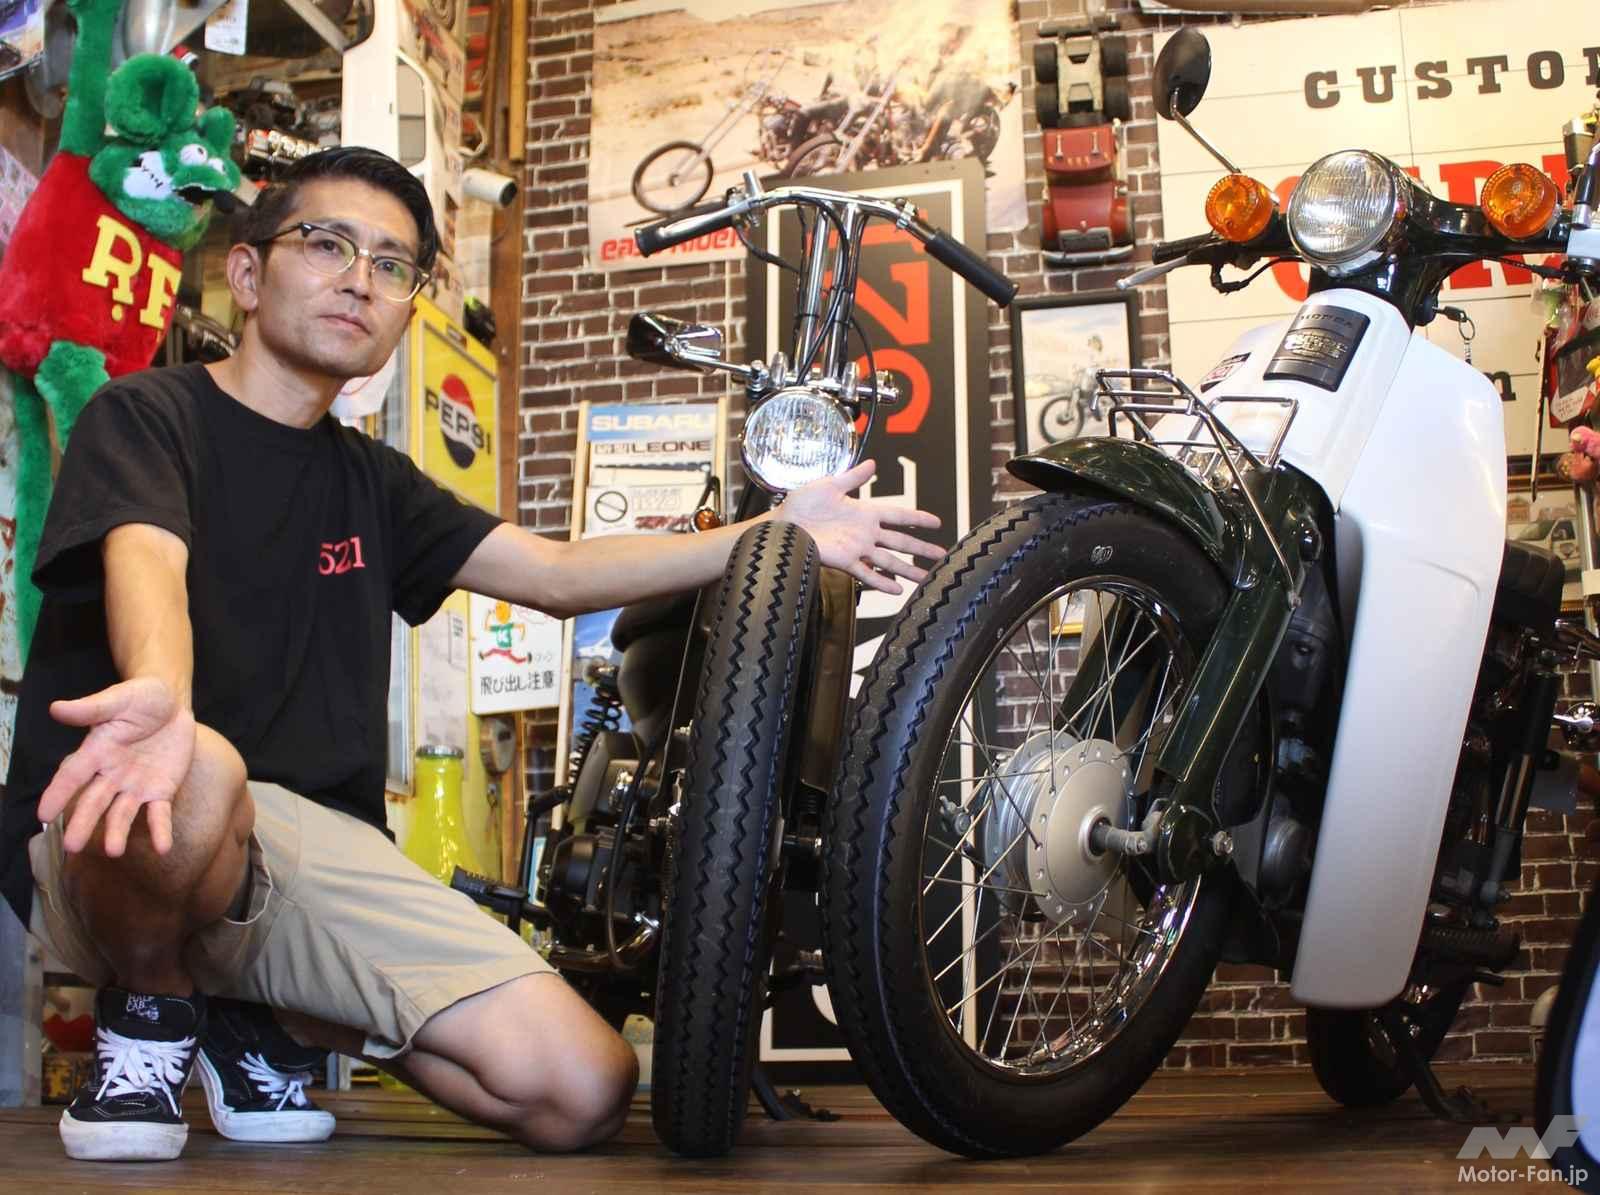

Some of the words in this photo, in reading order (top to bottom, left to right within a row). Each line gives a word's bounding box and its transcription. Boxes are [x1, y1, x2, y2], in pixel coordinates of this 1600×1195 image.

[425, 389, 491, 455] PEPSI
[591, 413, 715, 431] SUBARU
[633, 440, 711, 453] LEONE
[318, 536, 366, 576] 521
[480, 671, 554, 696] 飛び出し注意
